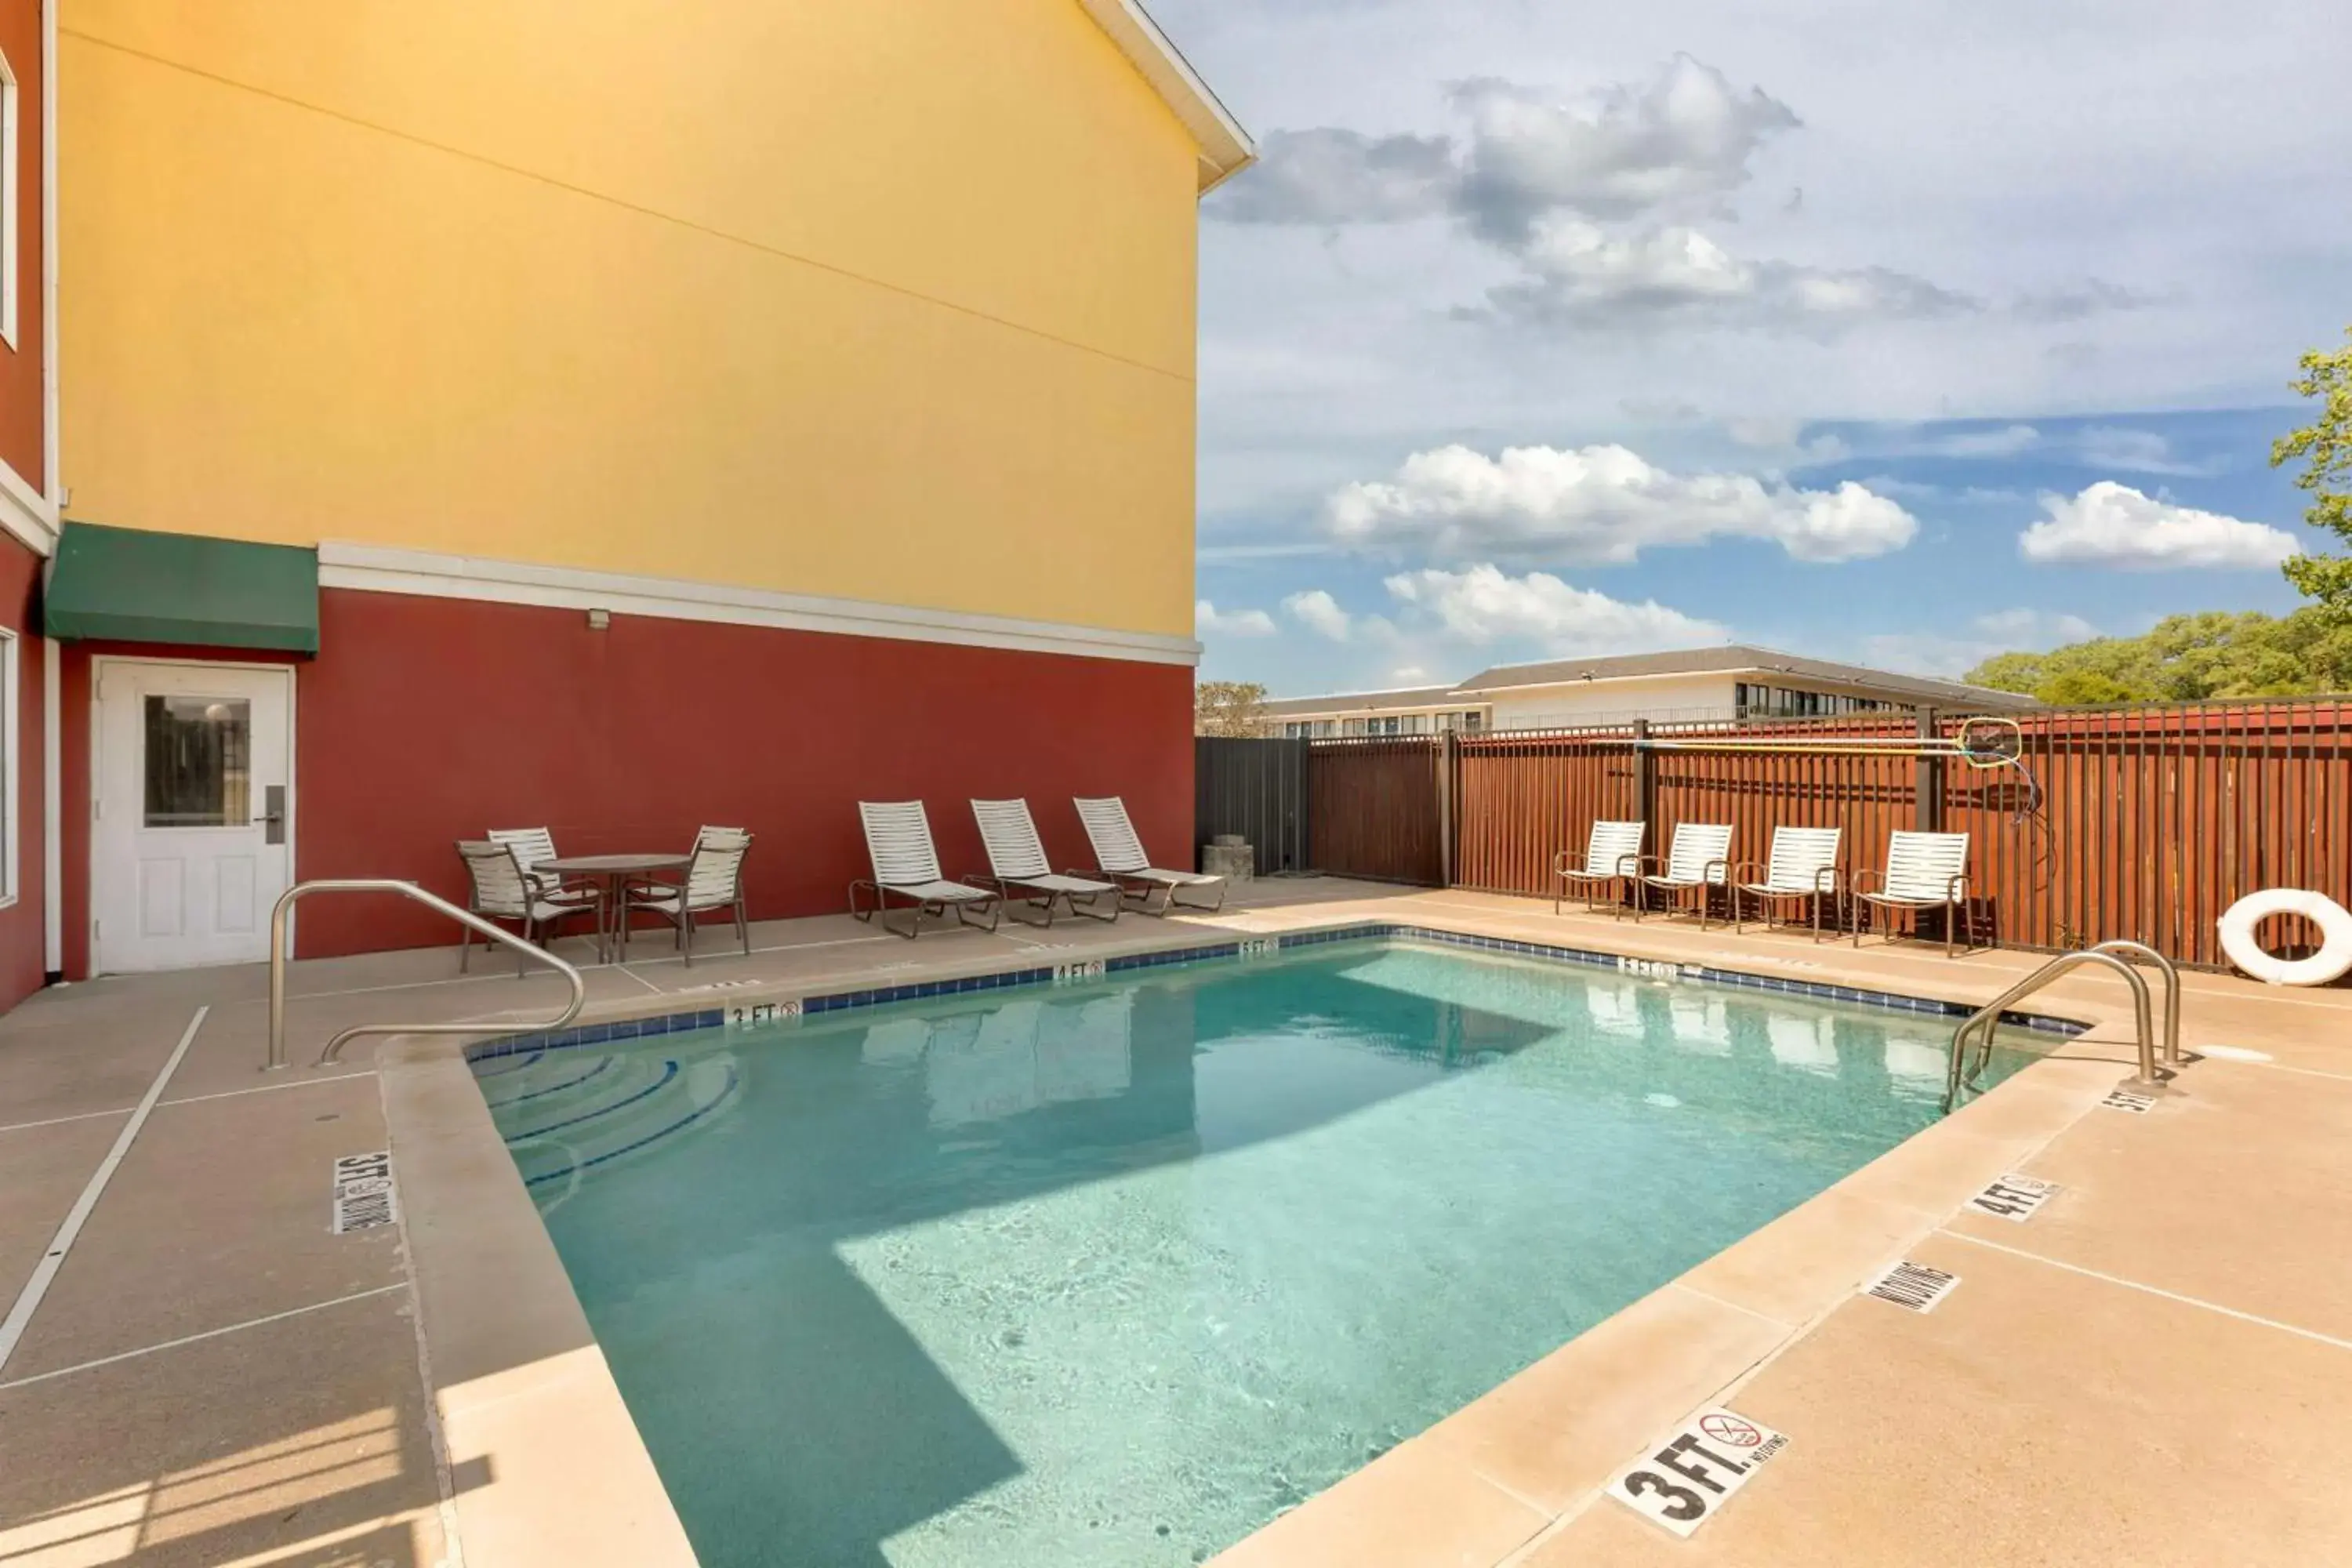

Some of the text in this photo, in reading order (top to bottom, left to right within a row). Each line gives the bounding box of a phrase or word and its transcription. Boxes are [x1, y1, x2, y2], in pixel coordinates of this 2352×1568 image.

[1071, 962, 1087, 978] FT
[753, 1004, 776, 1023] FT
[339, 1154, 388, 1167] 3
[1973, 1198, 2026, 1215] 4
[1624, 1471, 1706, 1521] 3
